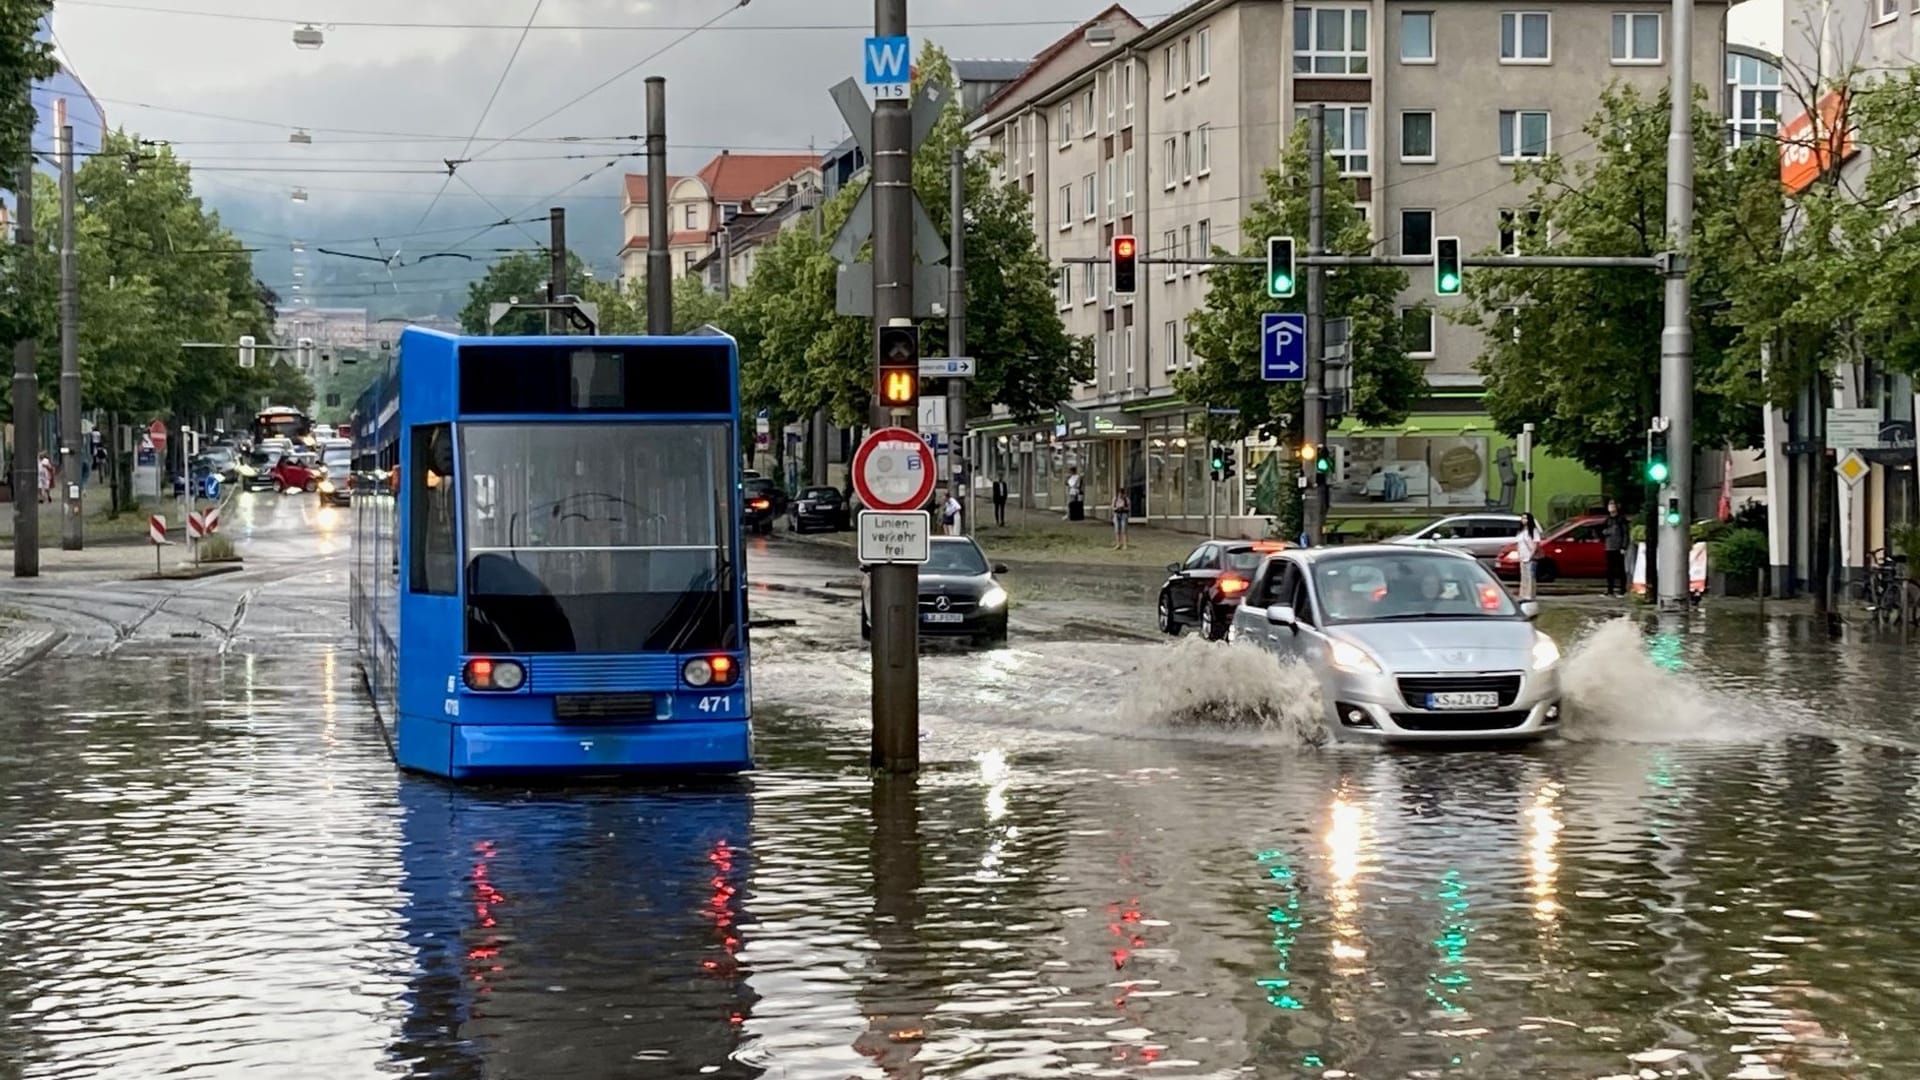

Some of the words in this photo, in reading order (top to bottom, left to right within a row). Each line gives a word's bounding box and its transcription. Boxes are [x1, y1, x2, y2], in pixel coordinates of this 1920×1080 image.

[868, 43, 906, 77] W
[872, 85, 904, 97] 115
[1276, 330, 1293, 357] P
[874, 517, 916, 529] Linien-
[872, 530, 917, 542] verkehr
[885, 544, 905, 556] frei
[698, 696, 731, 713] 471
